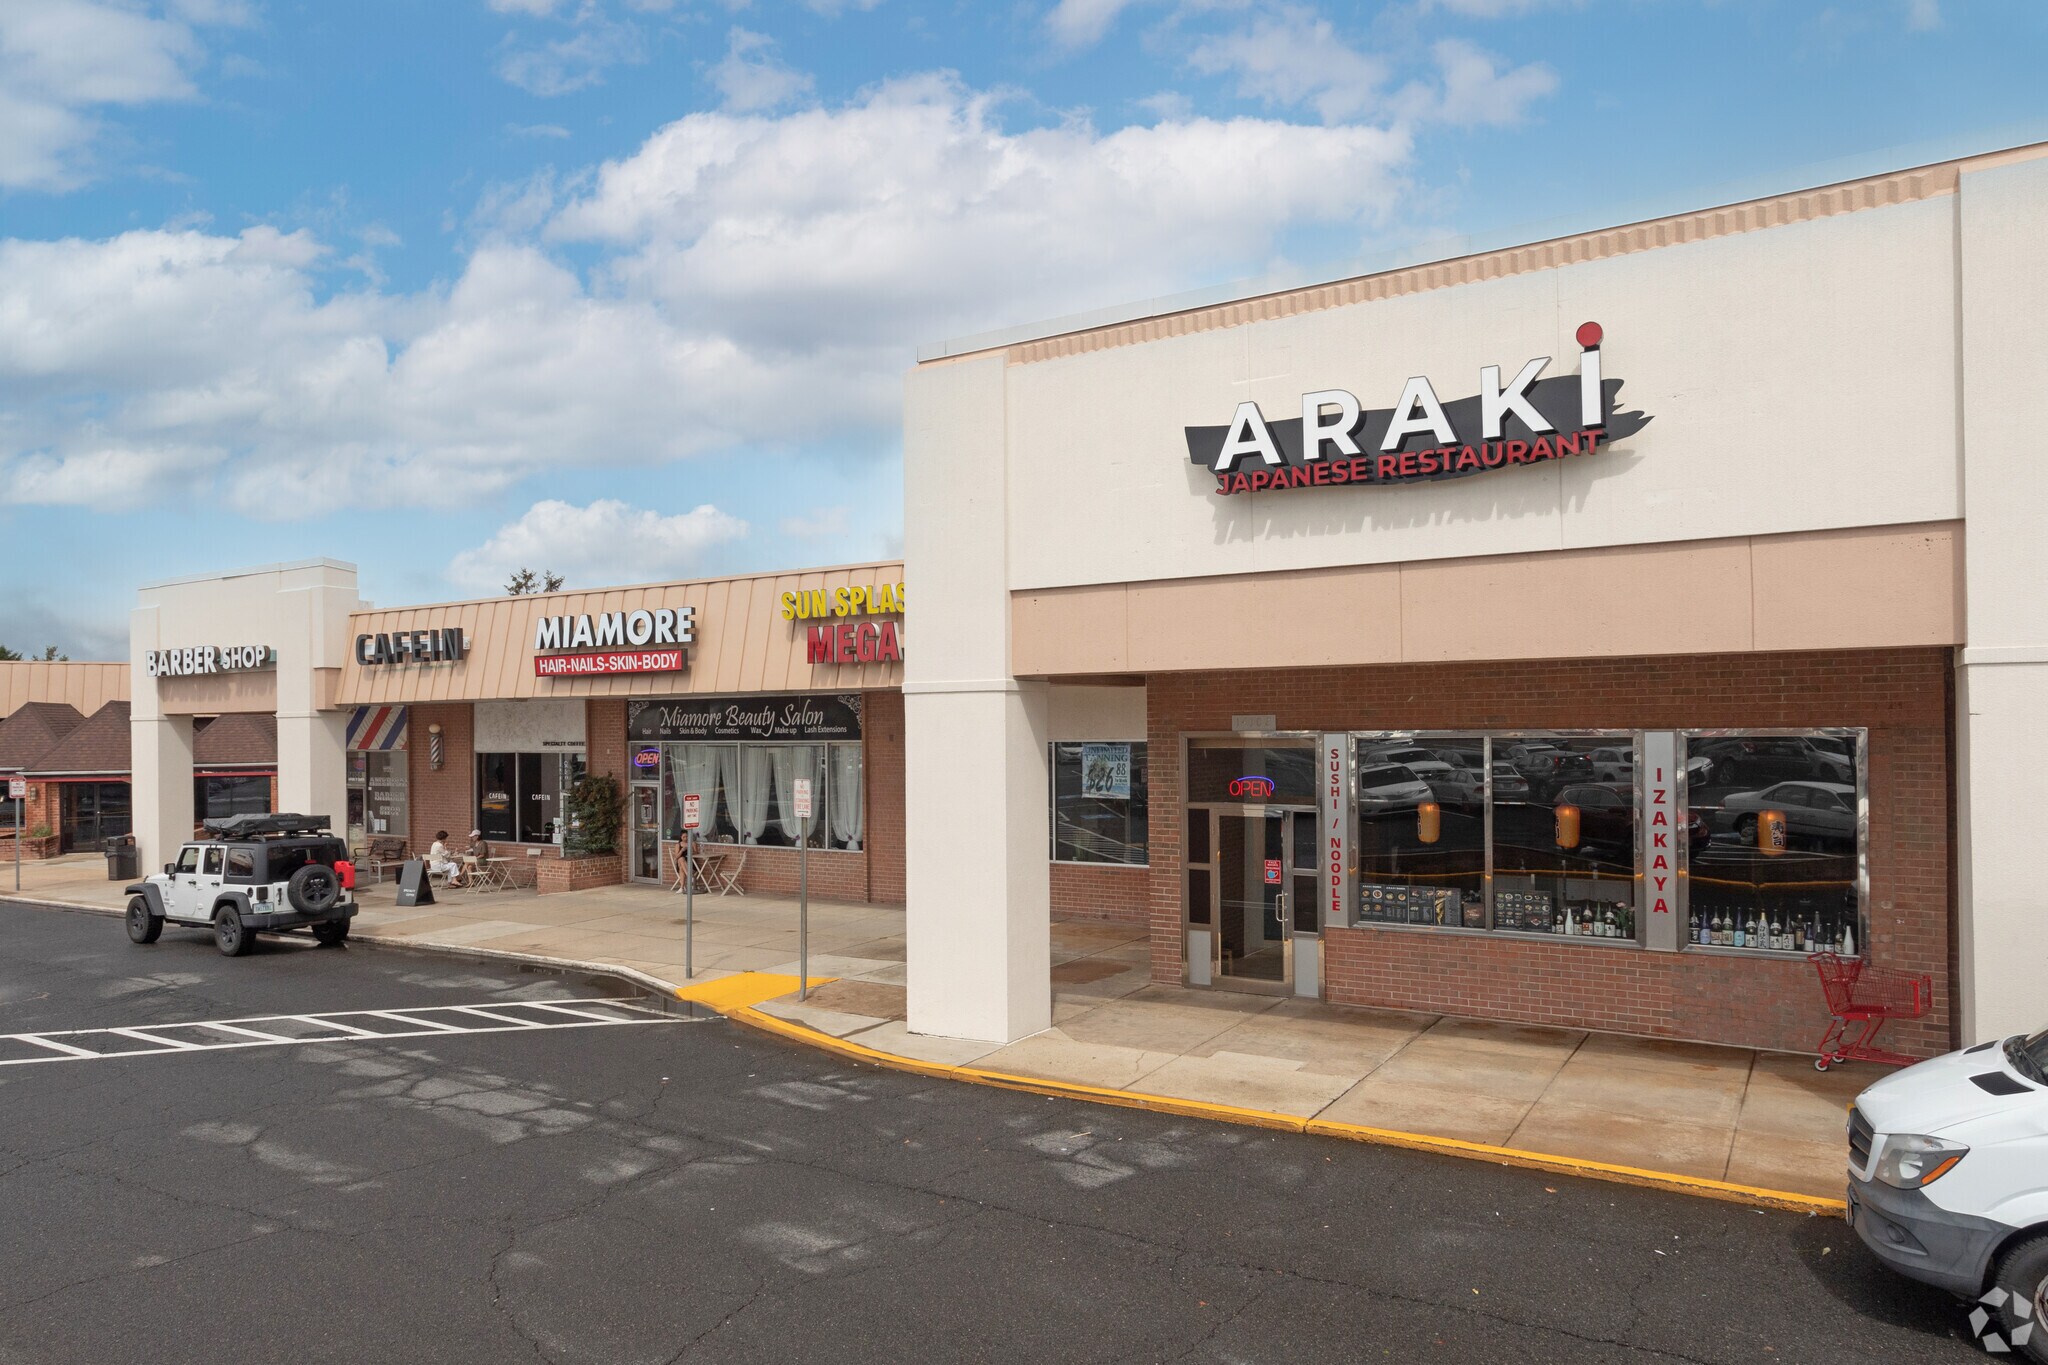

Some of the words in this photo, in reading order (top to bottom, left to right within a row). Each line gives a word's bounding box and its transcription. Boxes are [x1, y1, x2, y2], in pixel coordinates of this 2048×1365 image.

[1216, 457, 1369, 496] JAPANESE
[1377, 428, 1606, 479] RESTAURANT
[781, 589, 827, 620] SUN
[534, 607, 695, 650] MIAMORE
[807, 621, 900, 664] MEGA
[146, 646, 219, 677] BARBER
[222, 645, 268, 670] SHOP
[356, 627, 463, 665] CAFEIN
[539, 653, 678, 674] HAIR-NAILS-SKIN-BODY
[659, 706, 722, 727] Miamore
[725, 705, 776, 737] Beauty
[780, 699, 824, 727] Salon
[679, 727, 690, 735] Skin
[694, 727, 707, 736] Body
[818, 725, 847, 733] Extensions
[636, 753, 659, 764] OPEN
[1084, 745, 1128, 754] UNLIMITED
[1085, 753, 1128, 762] TANNING
[1116, 762, 1126, 775] 88
[1330, 748, 1340, 809] SUSHI
[489, 792, 507, 800] CAFEIN
[1229, 780, 1271, 797] OPEN
[1652, 767, 1669, 914] IZAKAYA
[1330, 837, 1341, 911] NOODLE
